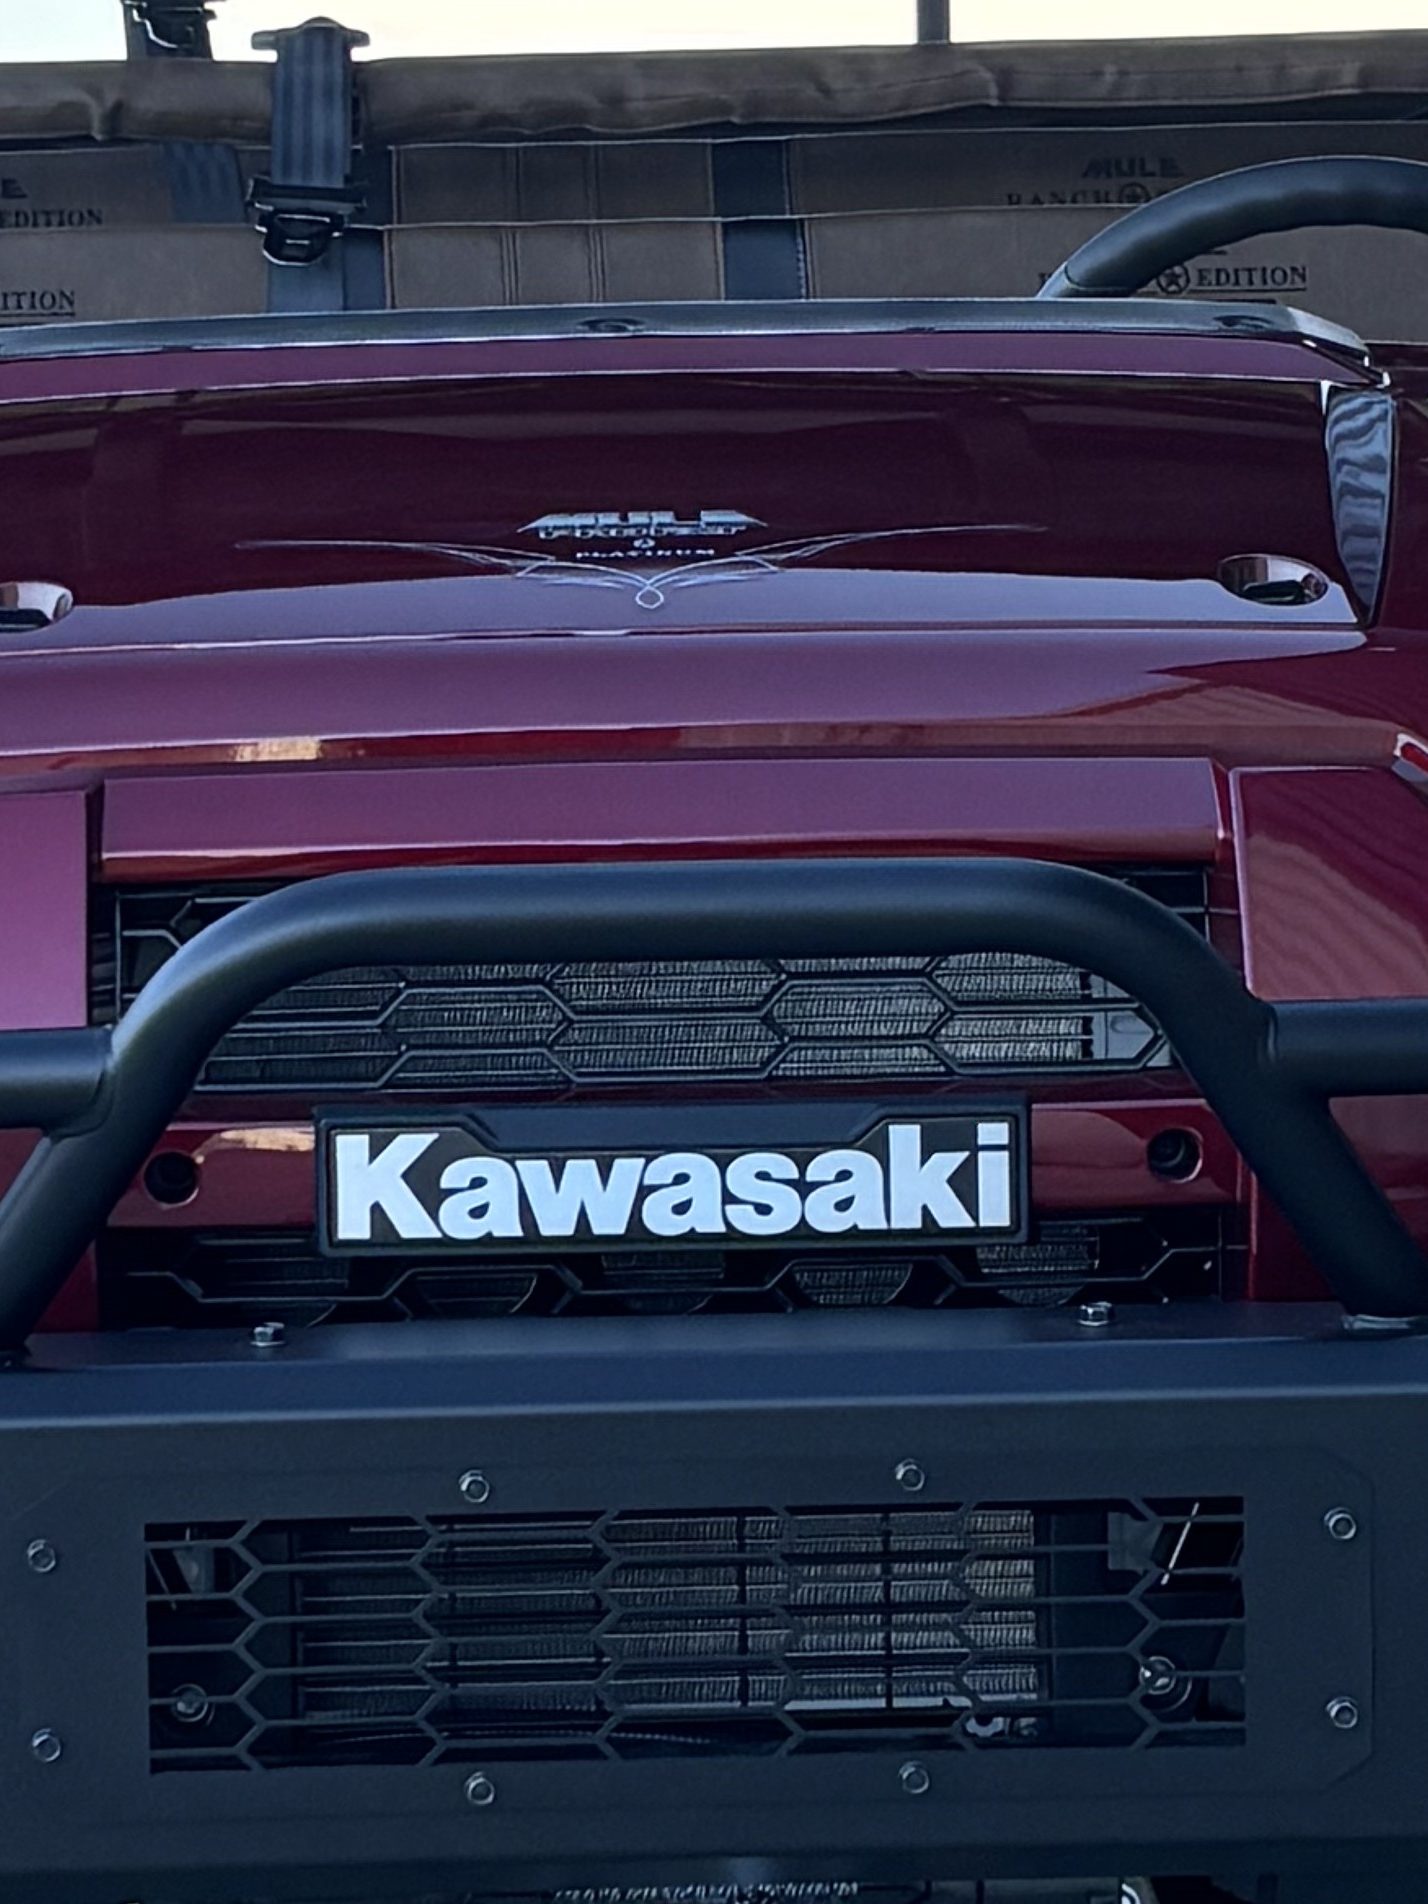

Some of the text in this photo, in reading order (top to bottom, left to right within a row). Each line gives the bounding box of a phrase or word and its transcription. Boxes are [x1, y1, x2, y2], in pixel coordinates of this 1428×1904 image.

[1080, 156, 1185, 179] MULE
[1197, 265, 1307, 288] EDITION
[335, 1122, 1010, 1241] Kawasaki
